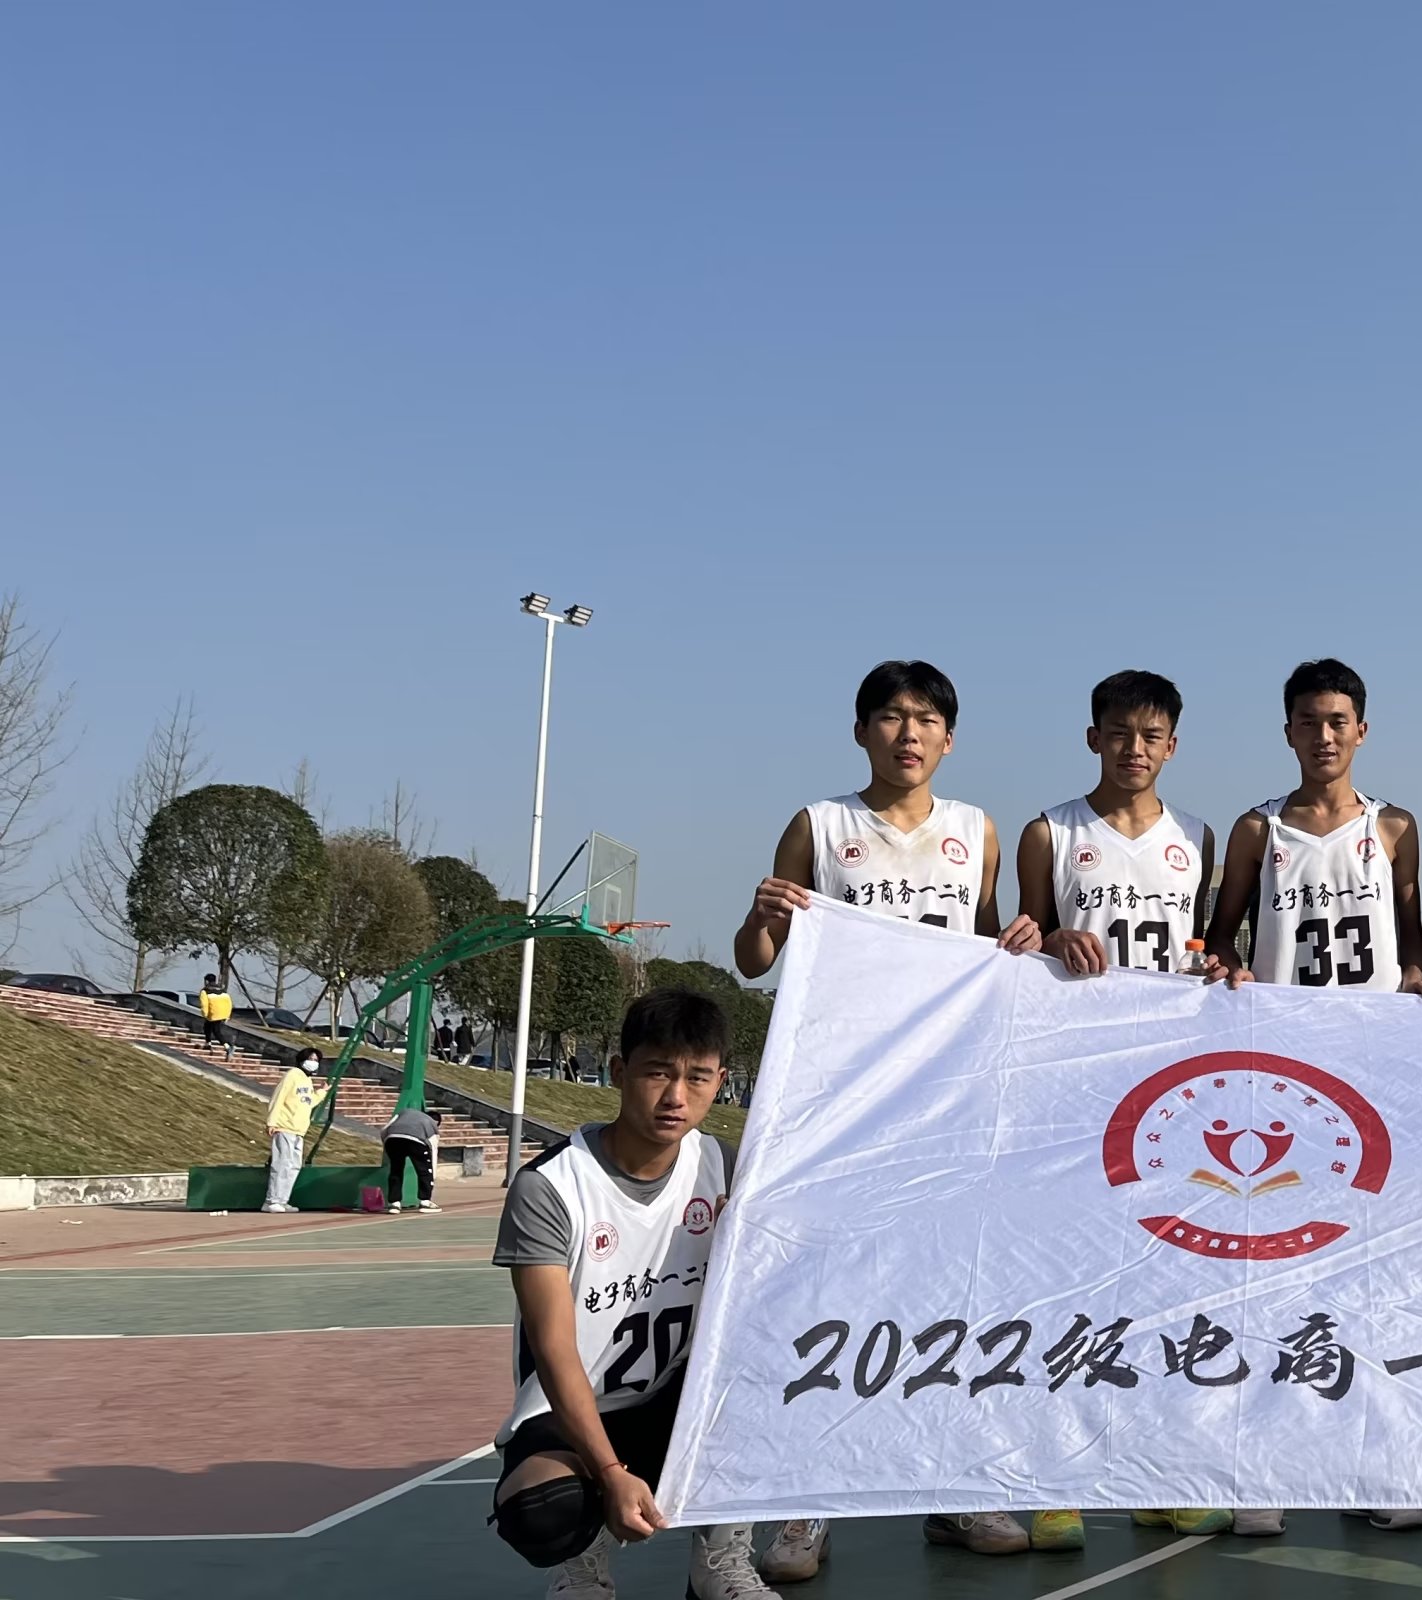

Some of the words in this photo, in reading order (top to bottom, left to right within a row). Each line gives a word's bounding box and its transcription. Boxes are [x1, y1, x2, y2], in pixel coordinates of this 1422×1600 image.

[843, 878, 969, 906] 电子商务一二班
[1075, 883, 1192, 914] 电子商务一二班
[1107, 918, 1170, 973] 13
[1295, 914, 1375, 987] 33
[603, 1303, 694, 1396] 20
